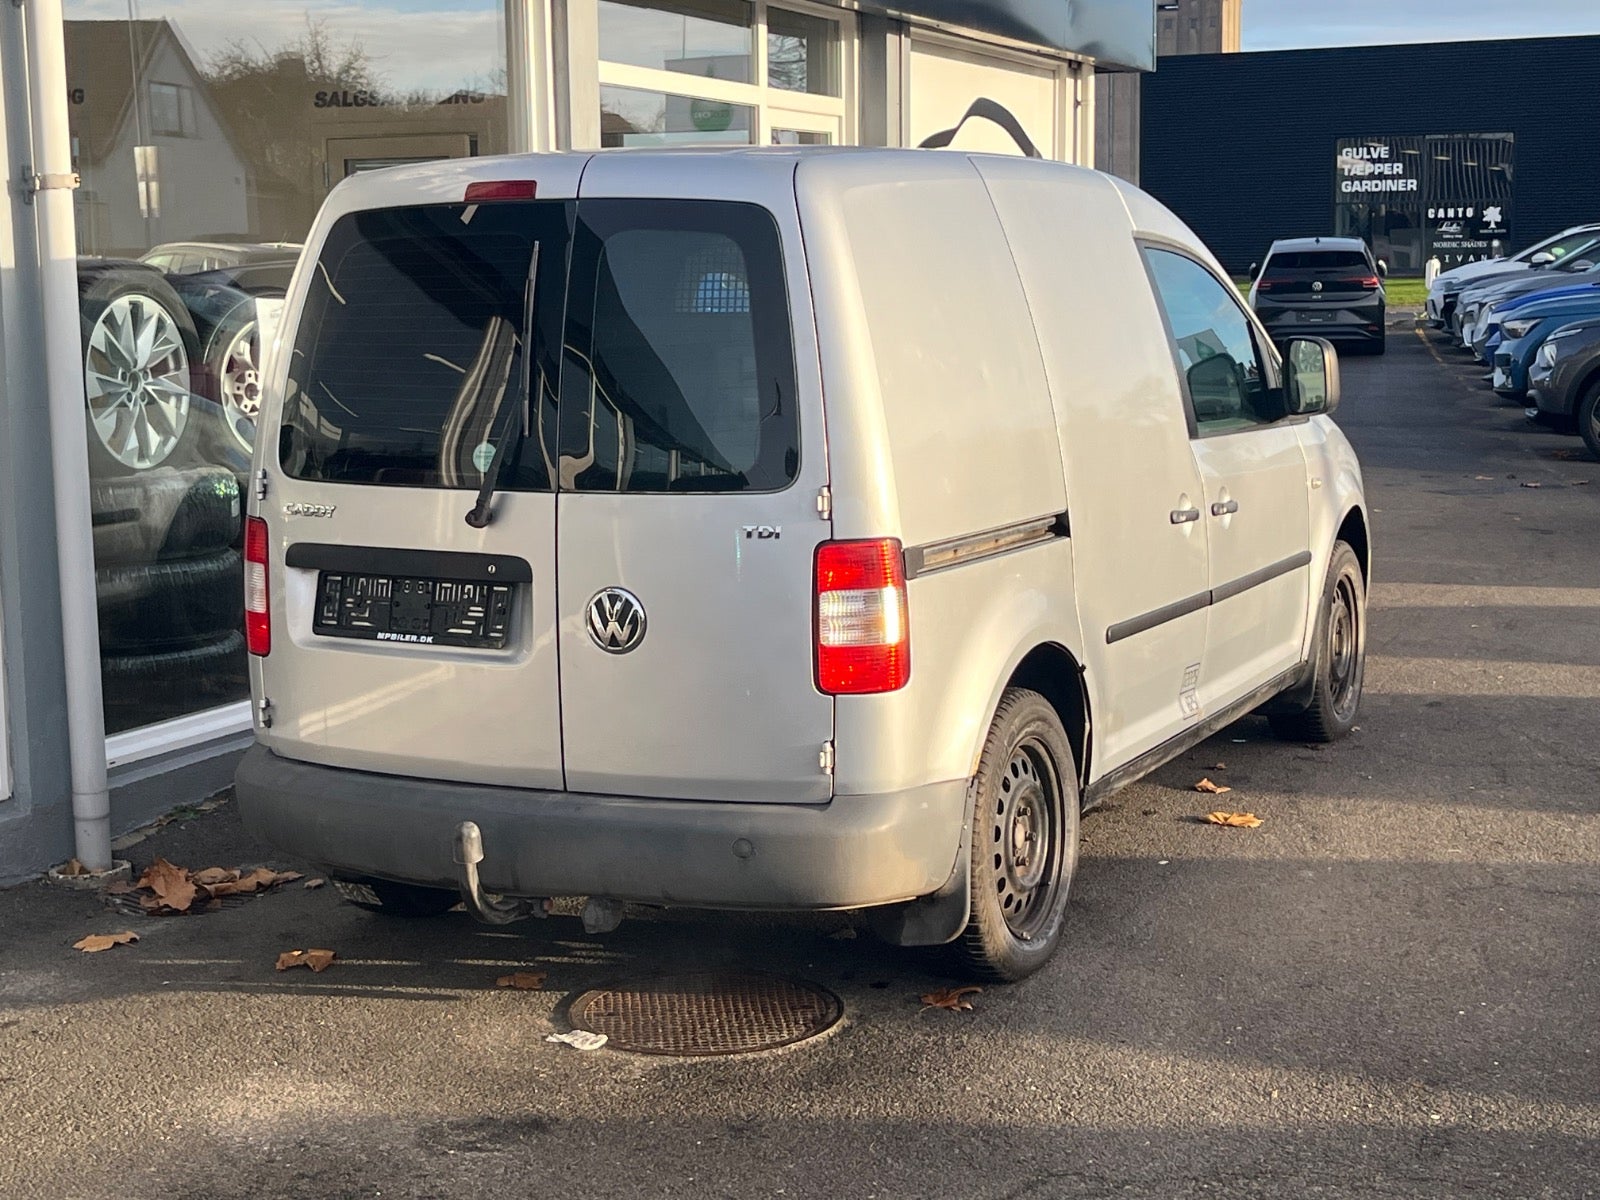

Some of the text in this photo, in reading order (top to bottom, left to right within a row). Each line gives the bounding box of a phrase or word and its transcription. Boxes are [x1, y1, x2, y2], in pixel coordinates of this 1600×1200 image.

[1342, 146, 1389, 159] GULVE
[1343, 163, 1403, 176] TÆPPER
[1341, 179, 1418, 193] GARDINER
[1427, 207, 1474, 219] CANTO
[282, 502, 337, 519] CADDY
[742, 525, 781, 540] TDI
